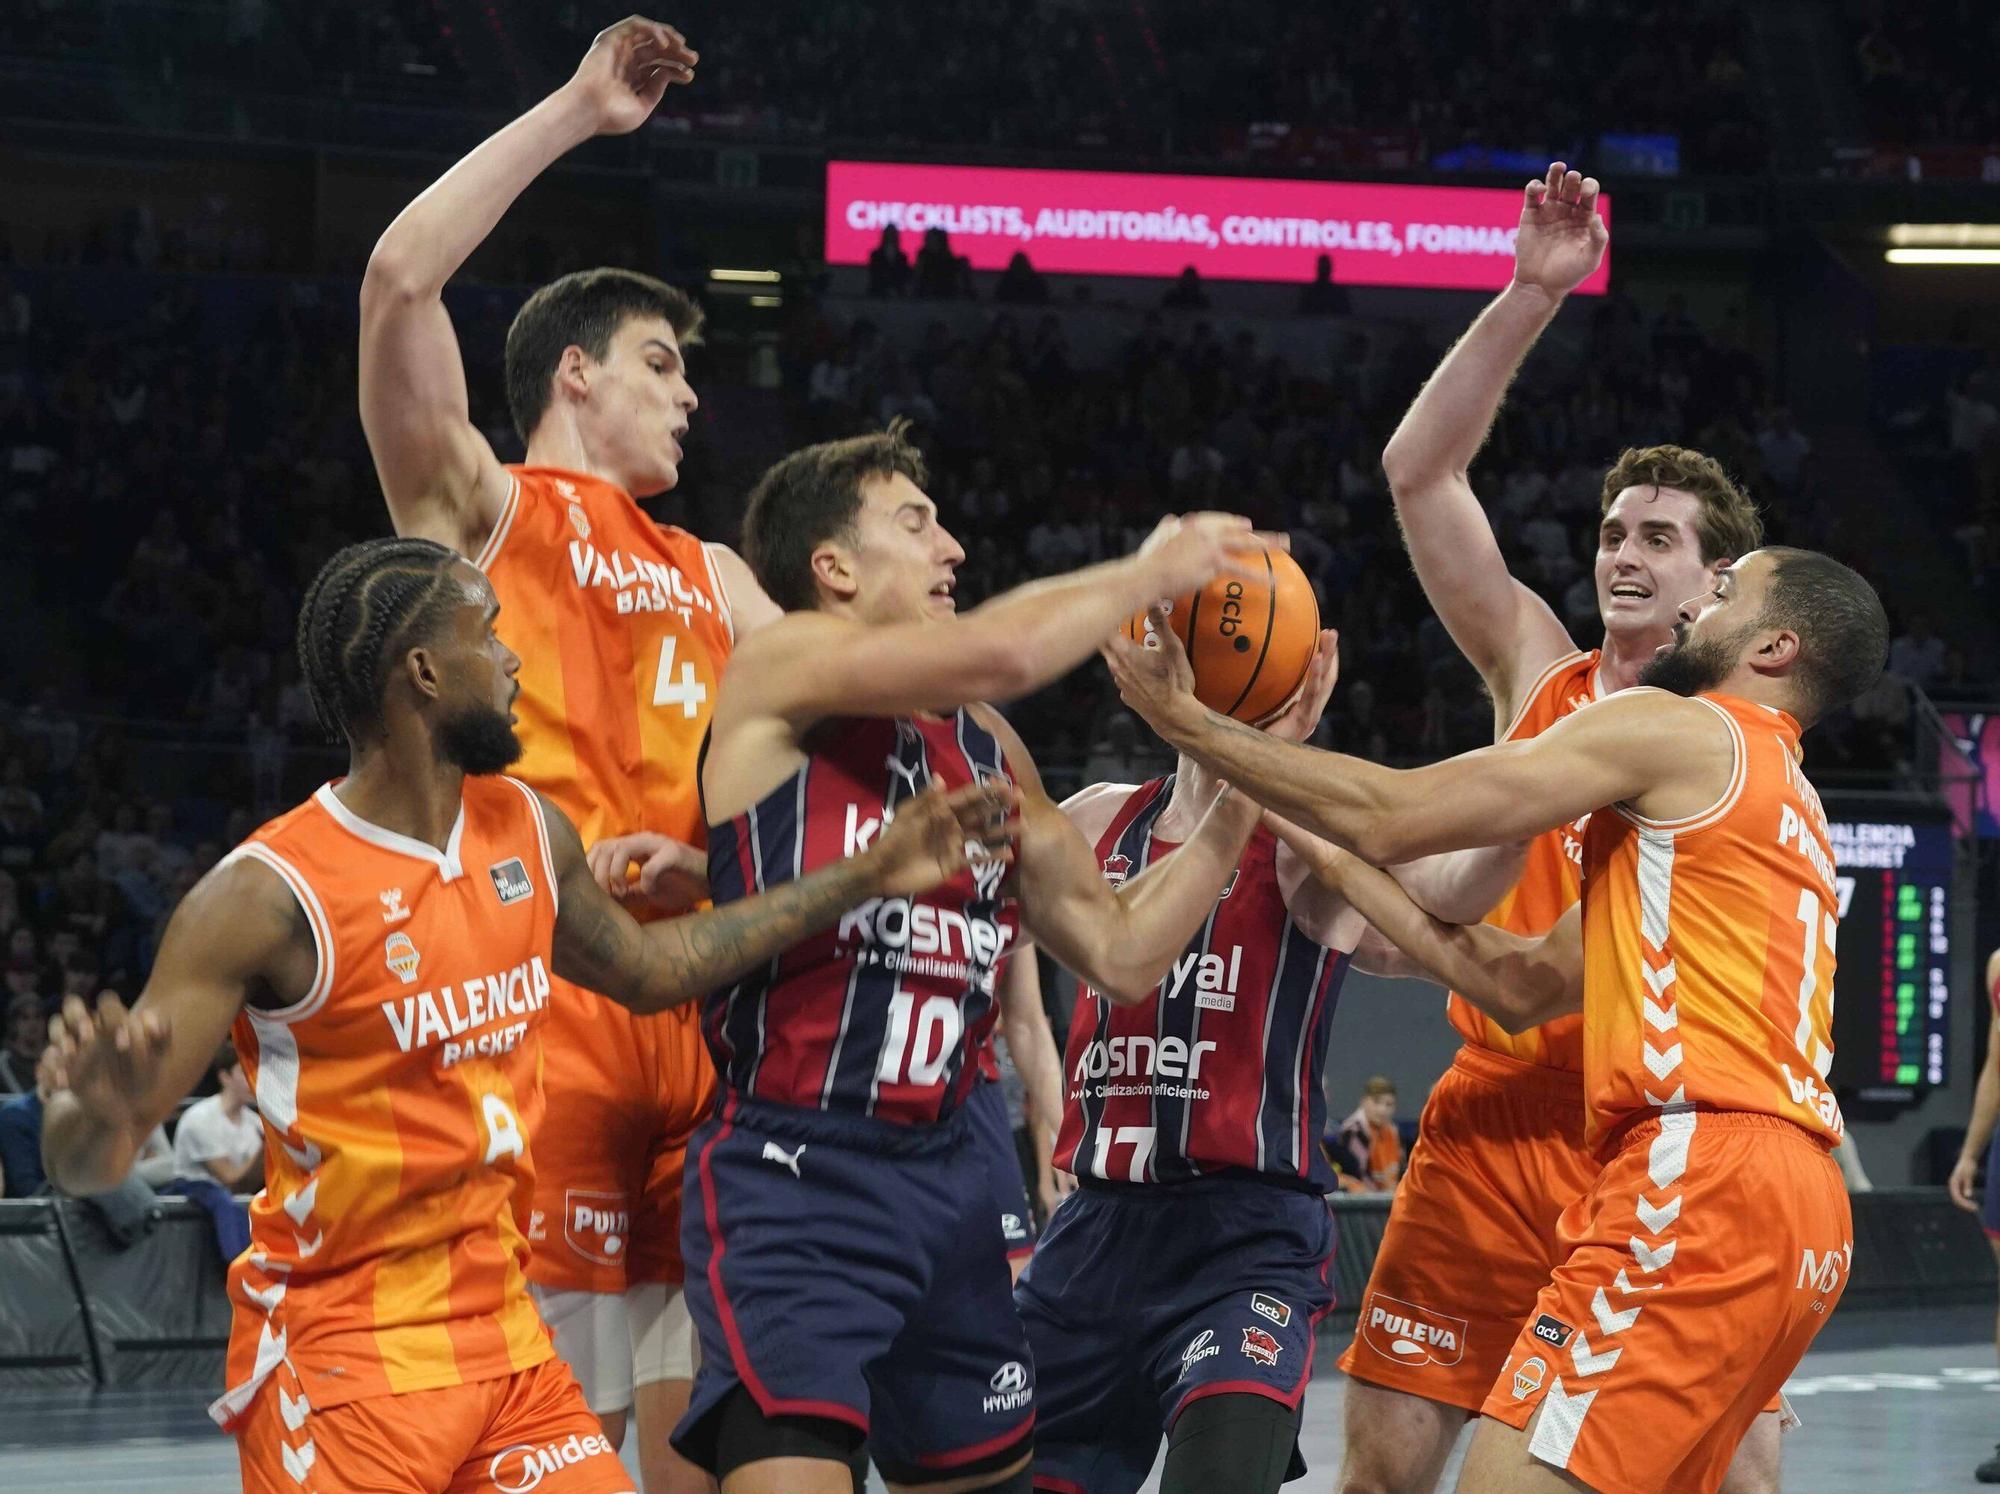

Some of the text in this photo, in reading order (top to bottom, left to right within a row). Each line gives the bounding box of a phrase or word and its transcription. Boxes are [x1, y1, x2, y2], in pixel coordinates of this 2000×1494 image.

[1034, 205, 1220, 249] AUDITORÍAS,
[1221, 215, 1403, 257] CONTROLES,
[1219, 581, 1244, 637] acb
[652, 635, 707, 718] 4
[381, 955, 550, 1053] VALENCIA
[1200, 995, 1232, 1009] media
[877, 991, 960, 1086] 10
[1154, 1083, 1211, 1100] eficiente
[1094, 1126, 1157, 1183] 17
[1255, 1302, 1280, 1320] acb
[1370, 1306, 1456, 1351] PULEVA
[1536, 1324, 1559, 1341] acb
[517, 1433, 613, 1487] Midea
